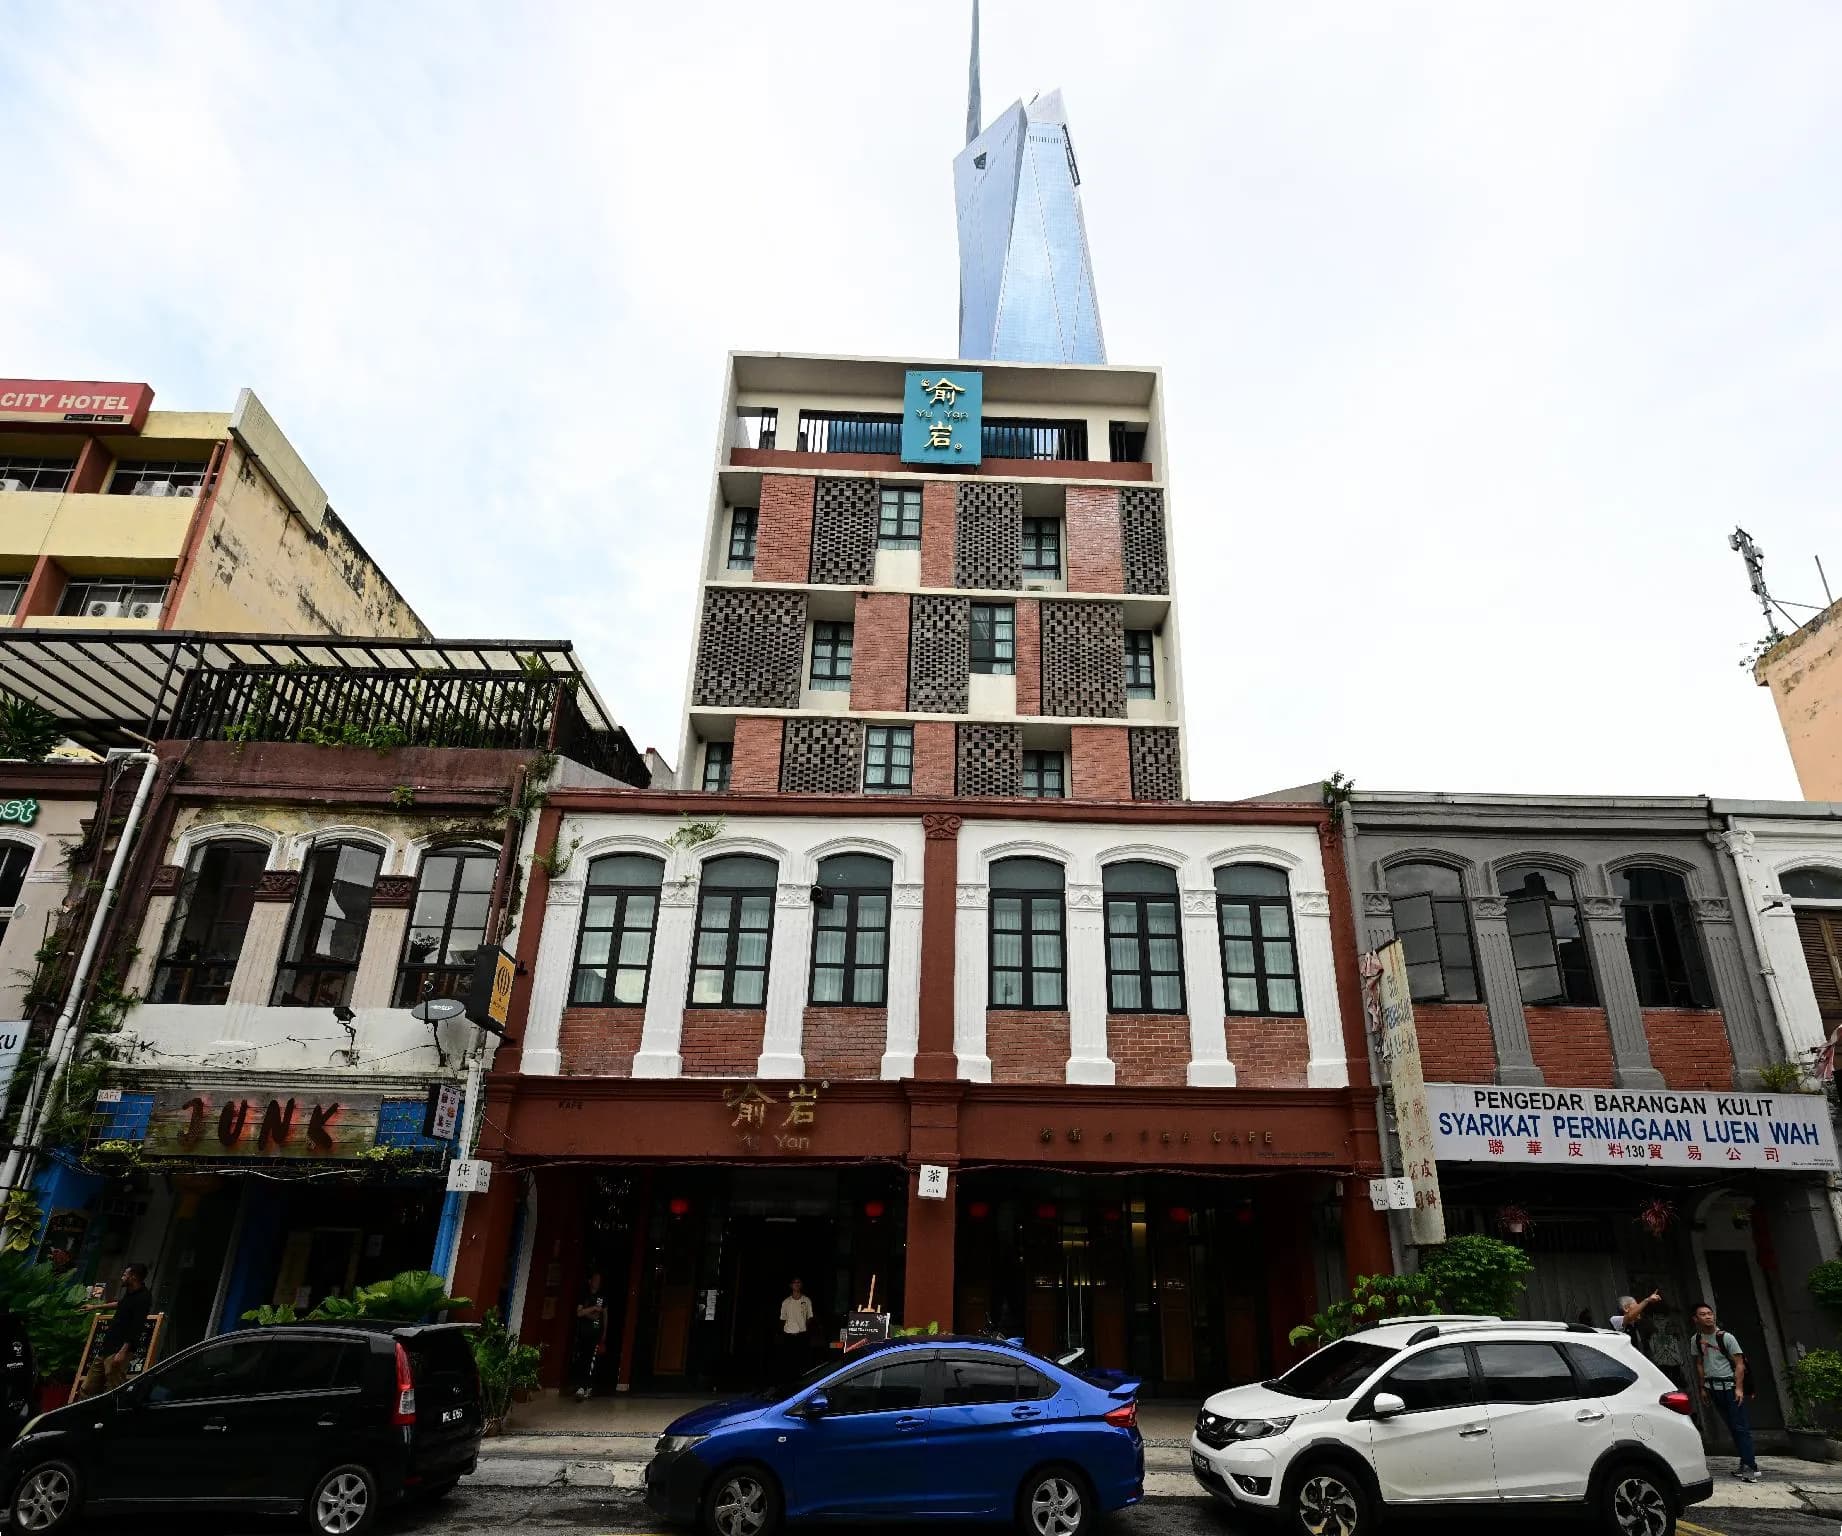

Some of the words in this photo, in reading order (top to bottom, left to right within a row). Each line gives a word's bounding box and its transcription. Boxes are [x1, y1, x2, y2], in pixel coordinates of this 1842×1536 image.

[1, 392, 54, 408] CITY
[57, 394, 129, 410] HOTEL
[916, 409, 933, 418] Yu
[944, 410, 968, 419] Yan
[0, 799, 36, 823] st
[1474, 1091, 1585, 1111] PENGEDAR
[1594, 1095, 1707, 1115] BARANGAN
[1717, 1098, 1773, 1116] KULIT
[177, 1097, 339, 1152] JUNK
[1439, 1112, 1541, 1137] SYARIKAT
[1553, 1116, 1693, 1142] PERNIAGAAN
[1703, 1120, 1760, 1144] LUEN
[1769, 1121, 1820, 1146] WAH
[1625, 1144, 1645, 1158] 130
[1648, 1143, 1780, 1163] 貿易公司
